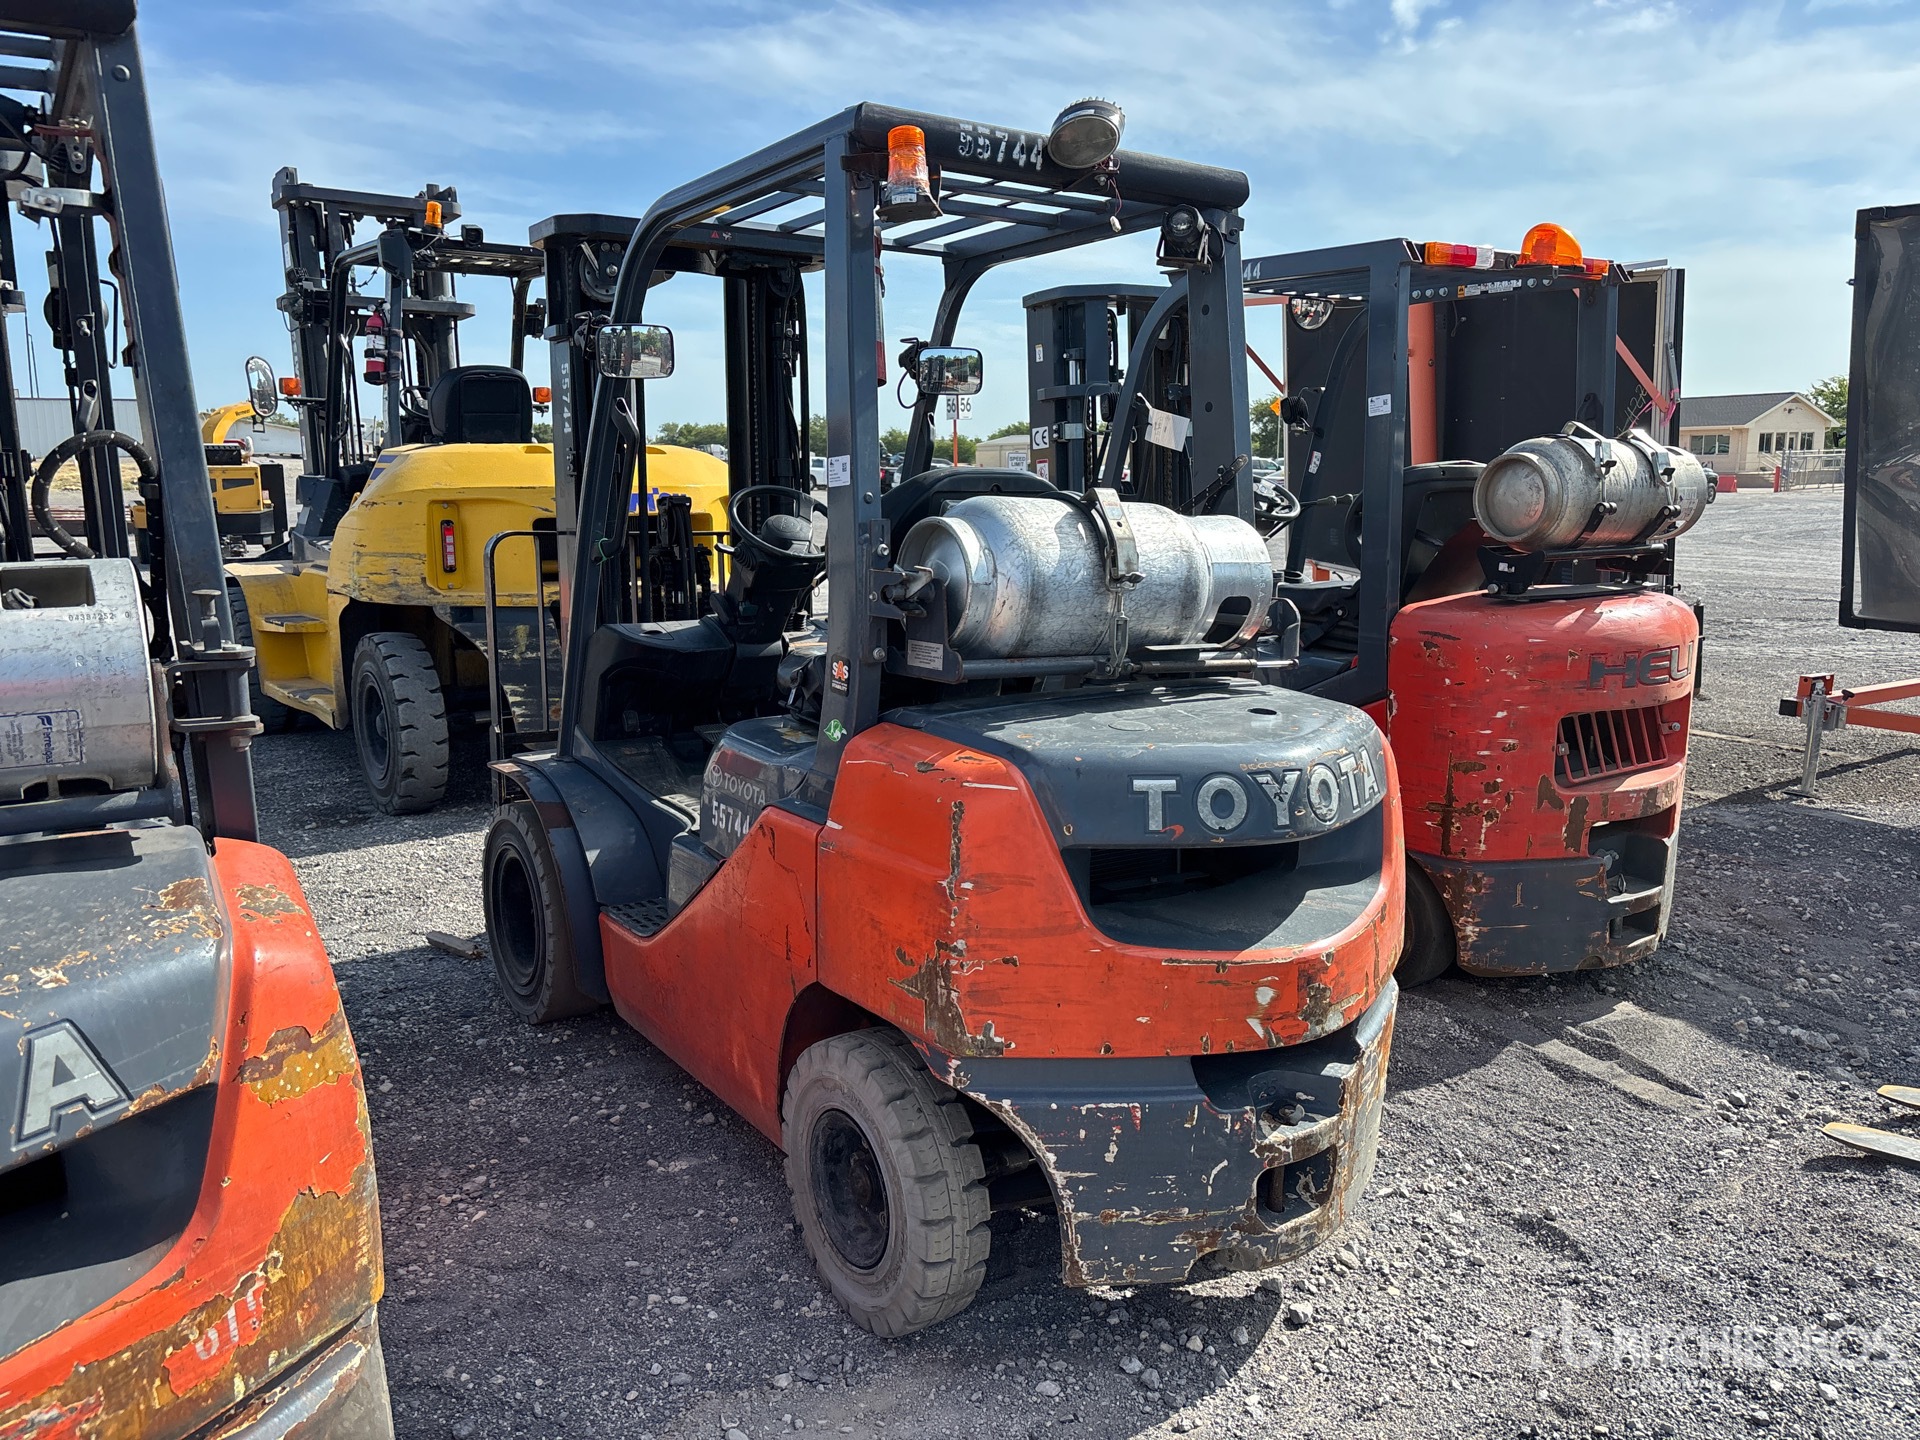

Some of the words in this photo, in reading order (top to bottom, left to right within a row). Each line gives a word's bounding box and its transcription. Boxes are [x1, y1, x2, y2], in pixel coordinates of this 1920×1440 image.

[959, 123, 1043, 171] 55744
[561, 362, 572, 434] 55744
[946, 399, 956, 413] 56
[960, 398, 972, 412] 56
[1033, 429, 1048, 447] CE
[832, 661, 849, 681] SAS
[42, 727, 54, 764] Ferrellgas
[724, 773, 766, 806] TOYOTA
[1132, 748, 1380, 827] TOYOTA
[712, 801, 750, 837] 55744
